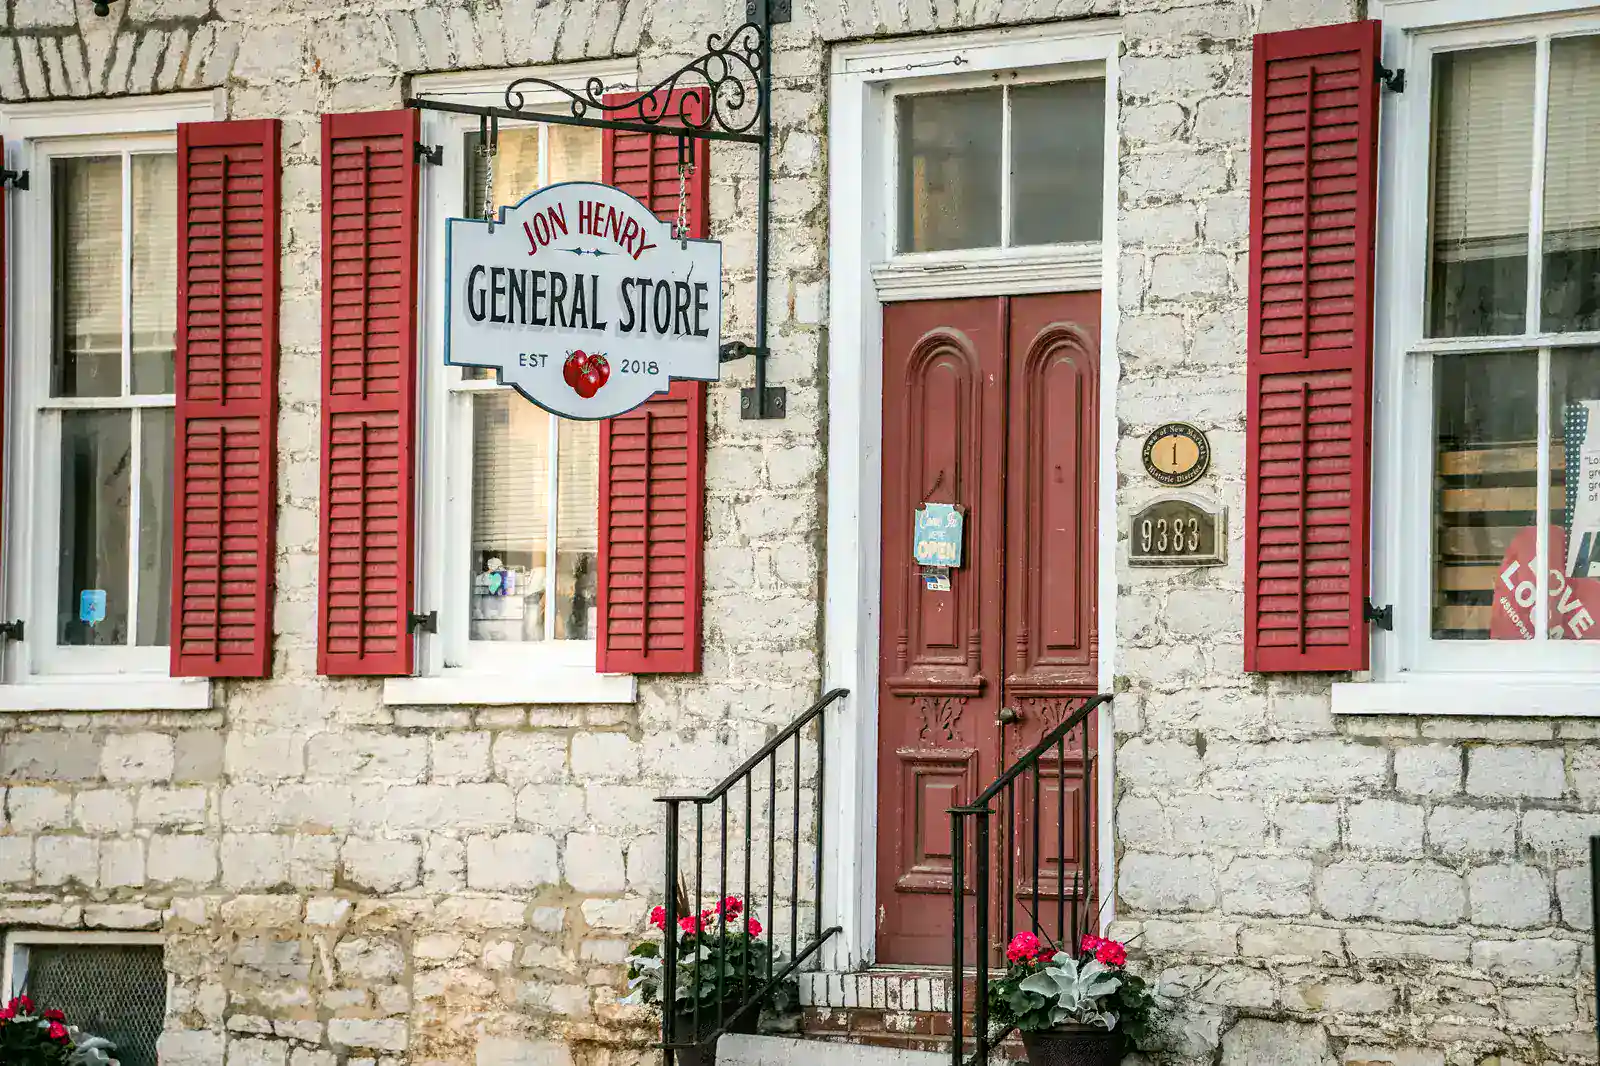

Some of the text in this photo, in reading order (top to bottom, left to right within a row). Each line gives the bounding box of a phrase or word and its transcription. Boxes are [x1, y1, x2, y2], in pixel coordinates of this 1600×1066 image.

[523, 200, 657, 261] JON HENRY
[467, 264, 709, 339] GENERAL STORE
[519, 353, 660, 376] EST 2018
[1169, 425, 1185, 433] New
[1171, 443, 1178, 466] 1
[1148, 465, 1202, 483] Historic District
[1141, 518, 1200, 553] 9383
[918, 540, 956, 560] OPEN
